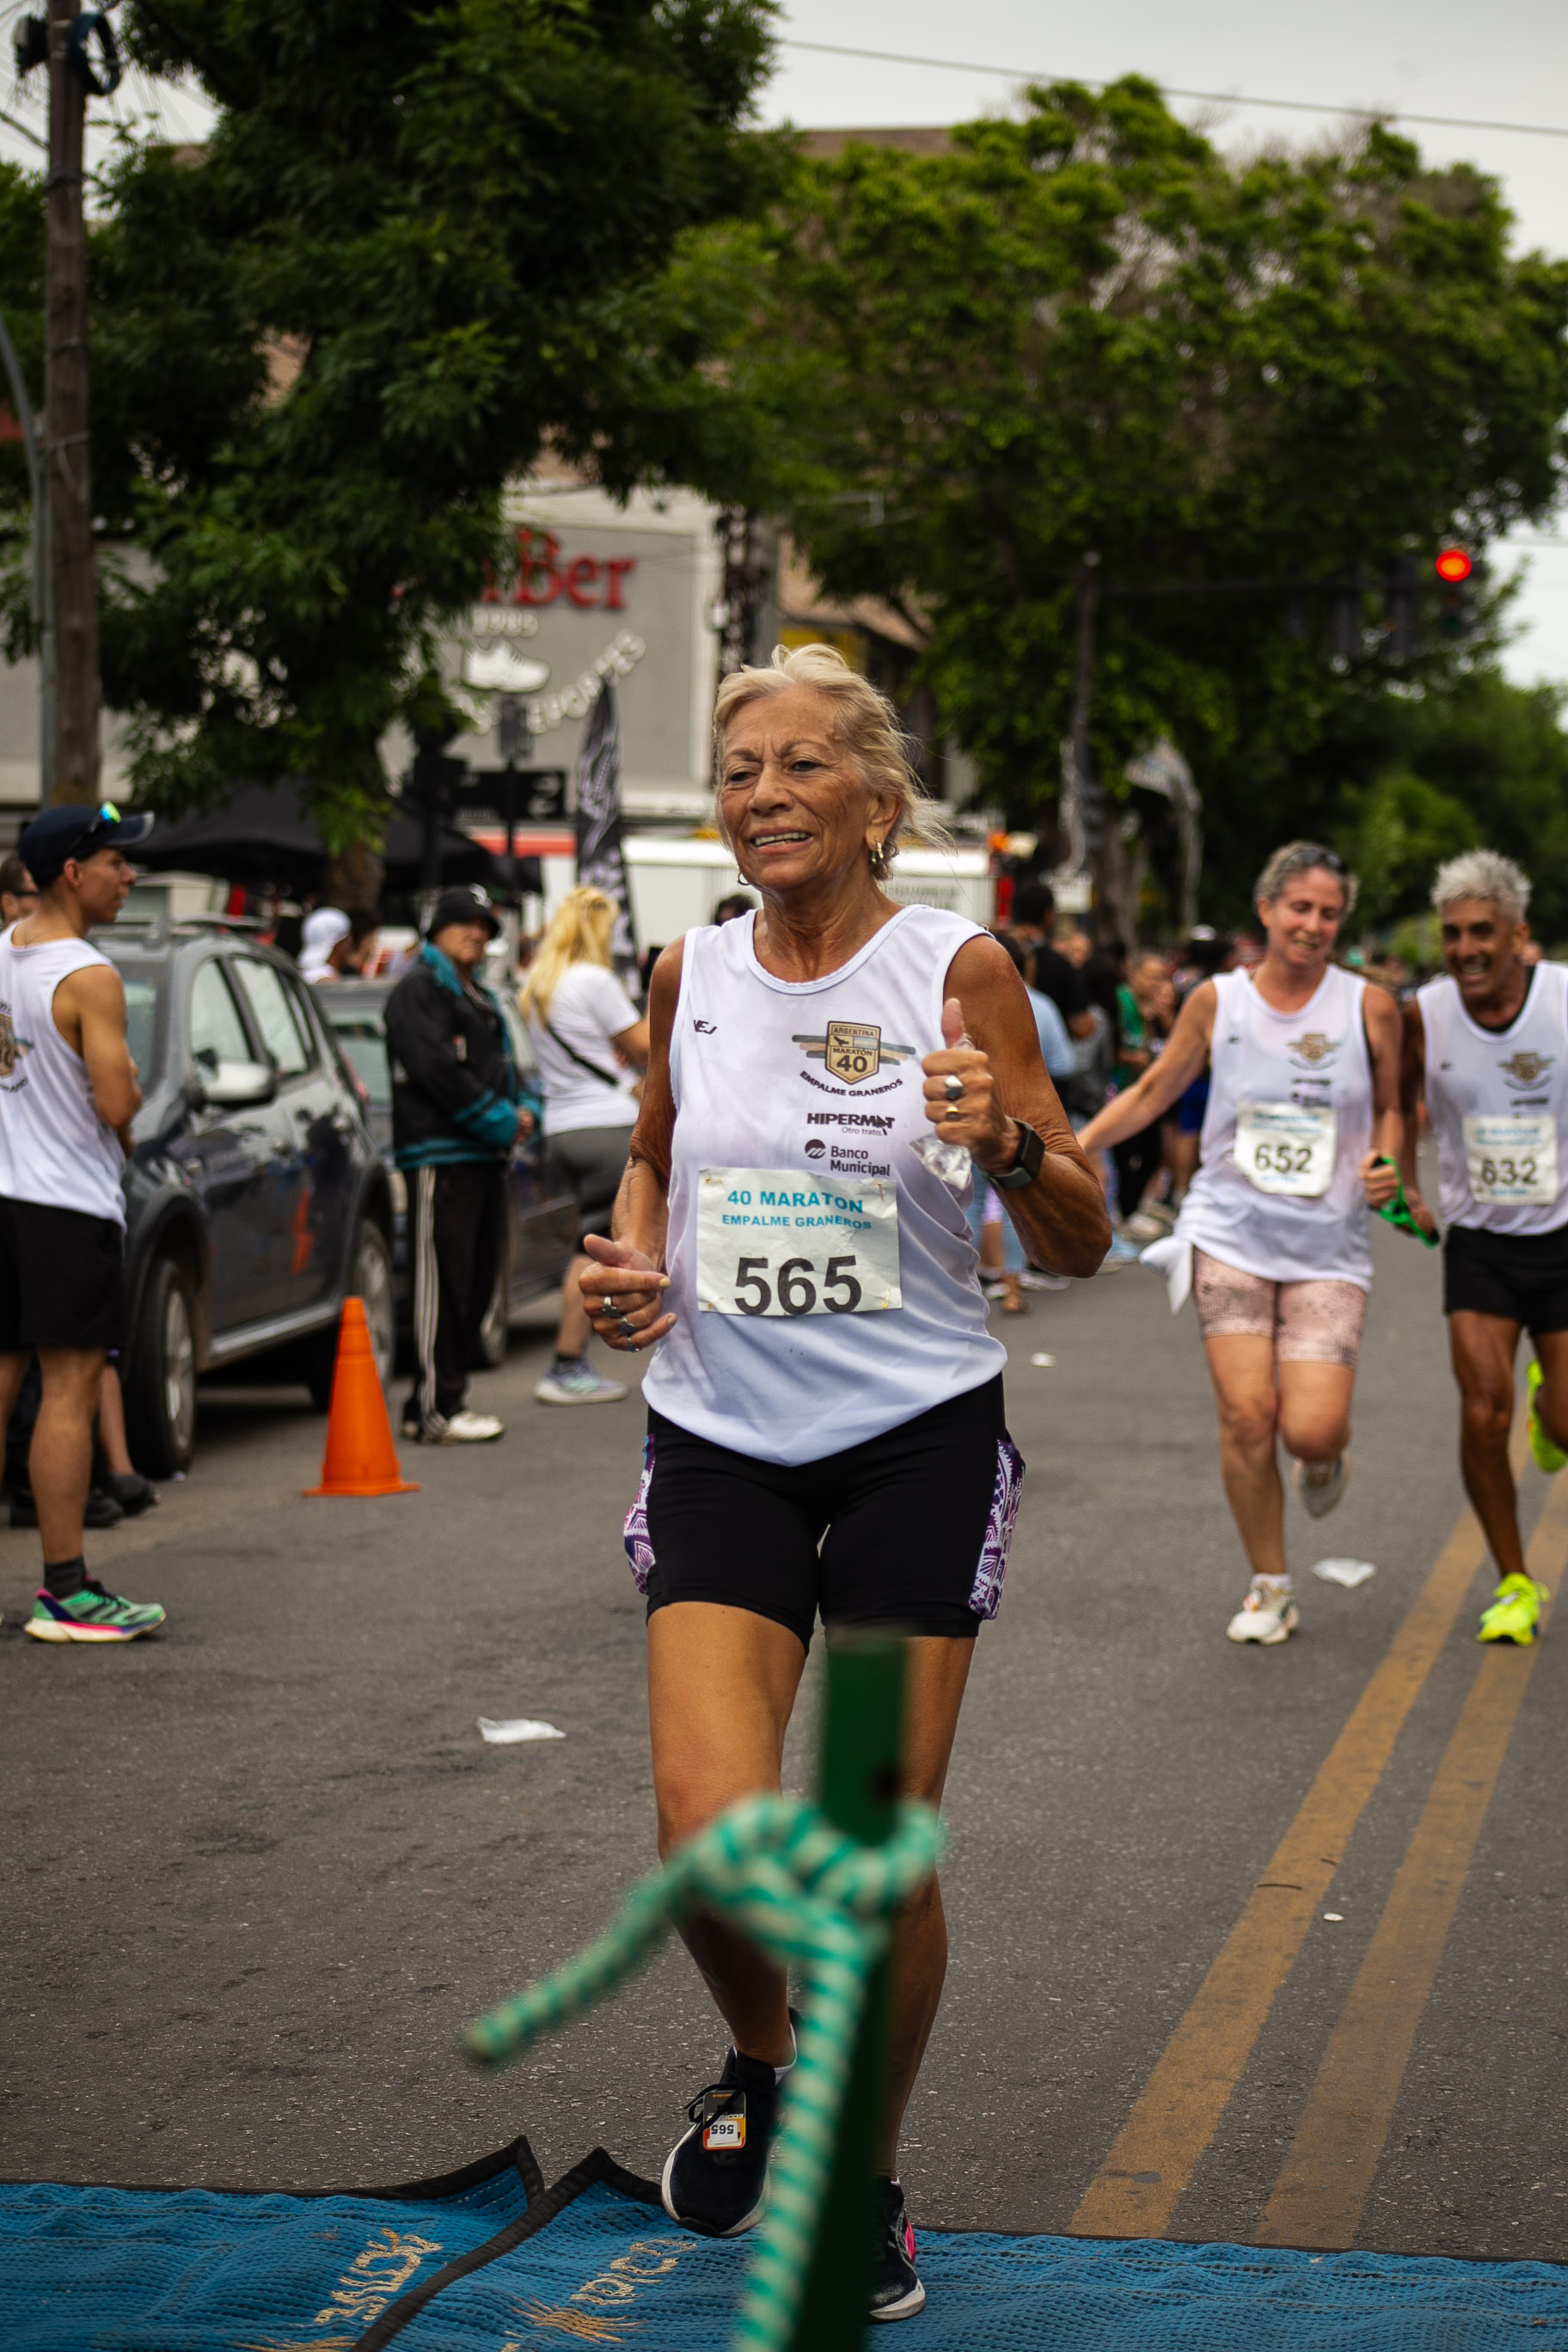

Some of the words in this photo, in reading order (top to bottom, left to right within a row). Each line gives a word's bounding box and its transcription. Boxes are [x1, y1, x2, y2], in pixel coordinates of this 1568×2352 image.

[833, 1026, 875, 1038] ARGENTINA
[836, 1055, 867, 1073] 40
[799, 1070, 847, 1096] EMPALME
[848, 1078, 903, 1097] GRANEROS
[841, 1126, 861, 1135] Otro
[830, 1145, 869, 1160] Banco
[1254, 1142, 1314, 1174] 652
[830, 1159, 891, 1178] Municipal
[1481, 1157, 1540, 1186] 632
[727, 1190, 752, 1205] 40
[760, 1191, 864, 1214] MARATON
[722, 1214, 791, 1227] EMPALME
[794, 1216, 873, 1230] GRANEROS
[734, 1255, 862, 1316] 565
[711, 2124, 735, 2135] 565
